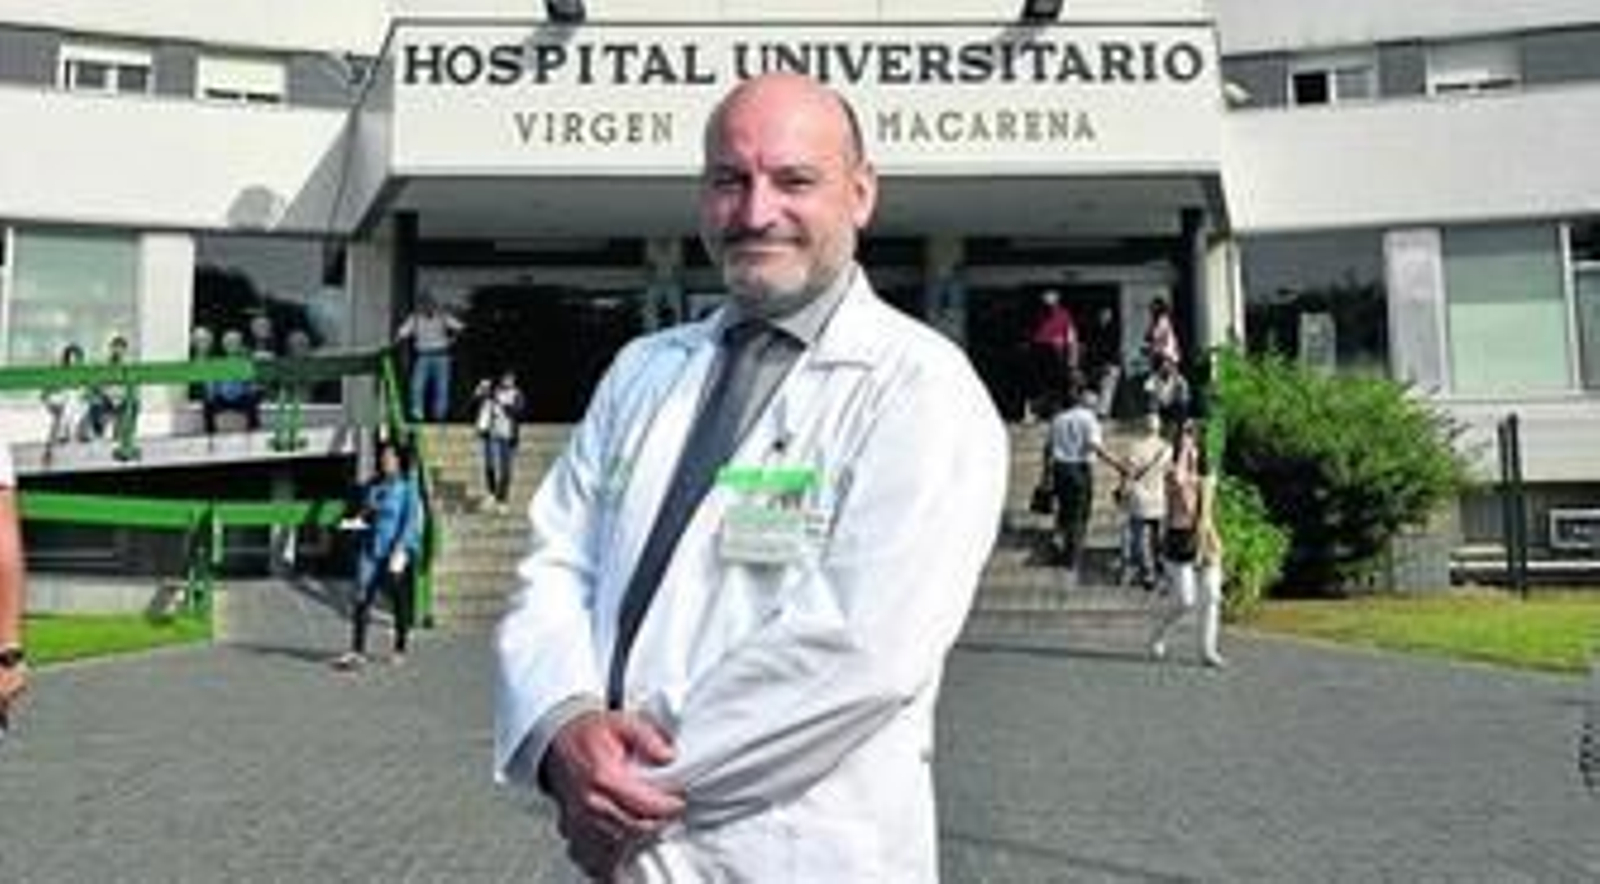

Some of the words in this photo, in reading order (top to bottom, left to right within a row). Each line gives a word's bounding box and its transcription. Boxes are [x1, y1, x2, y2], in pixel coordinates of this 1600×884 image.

[403, 44, 716, 85] HOSPITAL
[734, 43, 1204, 84] UNIVERSITARIO
[513, 111, 675, 144] VIRGEN
[877, 111, 1097, 142] MACARENA
